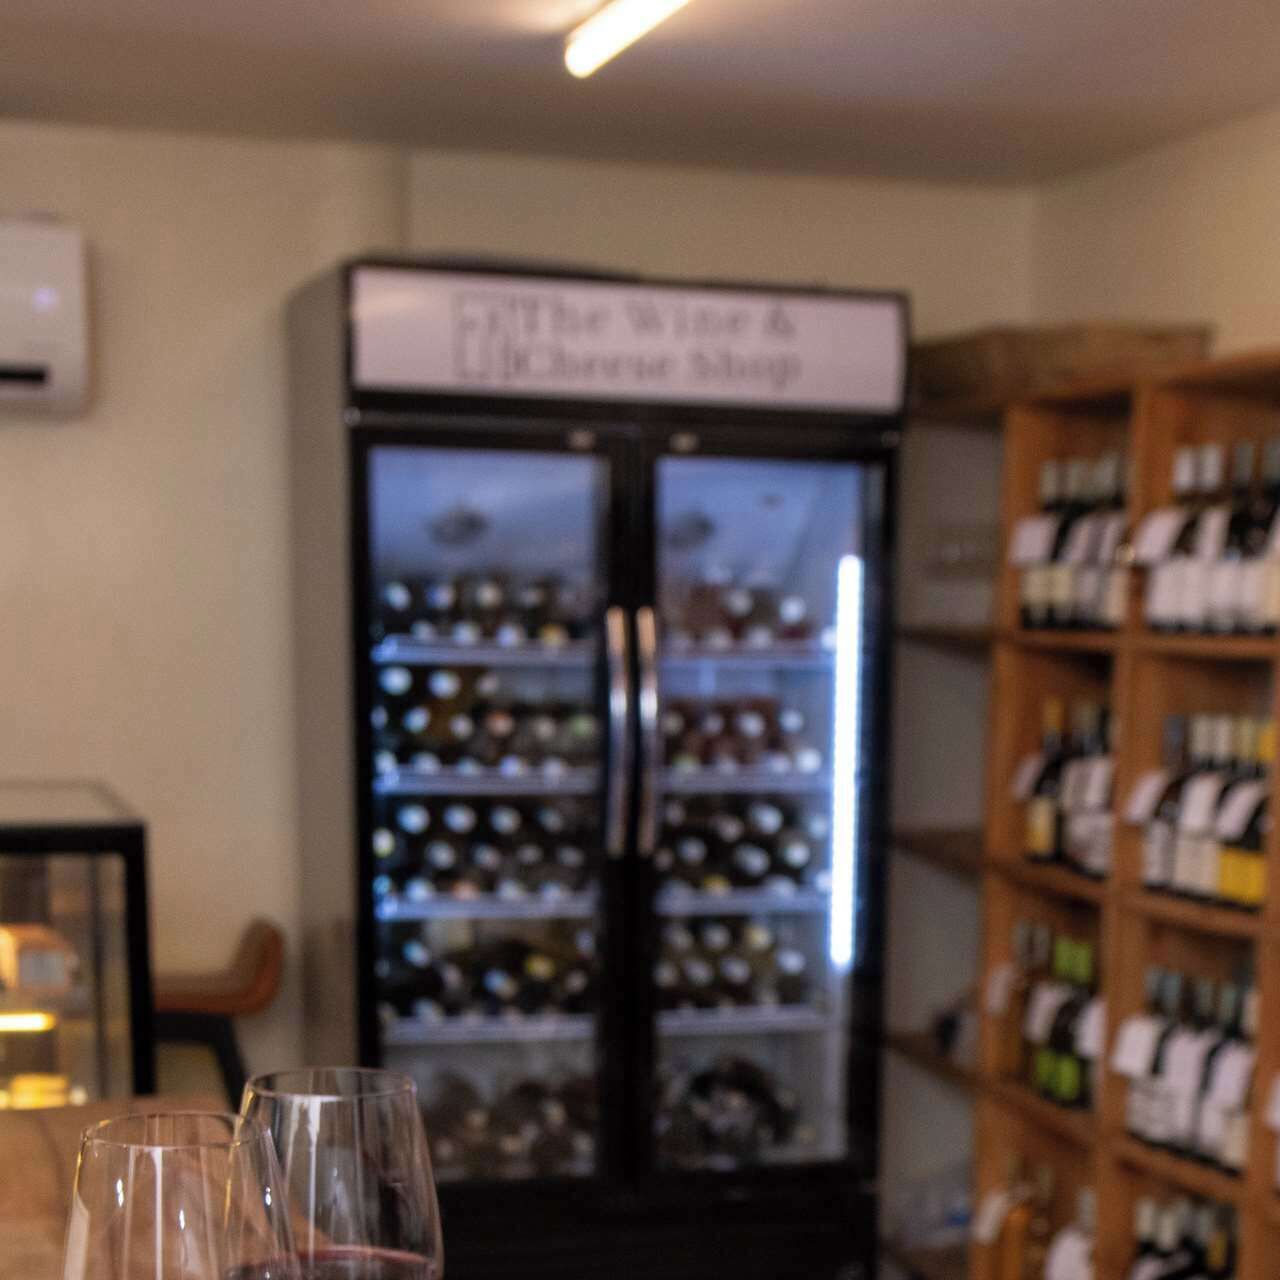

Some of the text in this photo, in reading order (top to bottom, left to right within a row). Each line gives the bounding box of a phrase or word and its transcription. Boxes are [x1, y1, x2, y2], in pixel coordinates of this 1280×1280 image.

[508, 293, 612, 335] The
[624, 299, 752, 341] Wine
[684, 347, 804, 390] Shop
